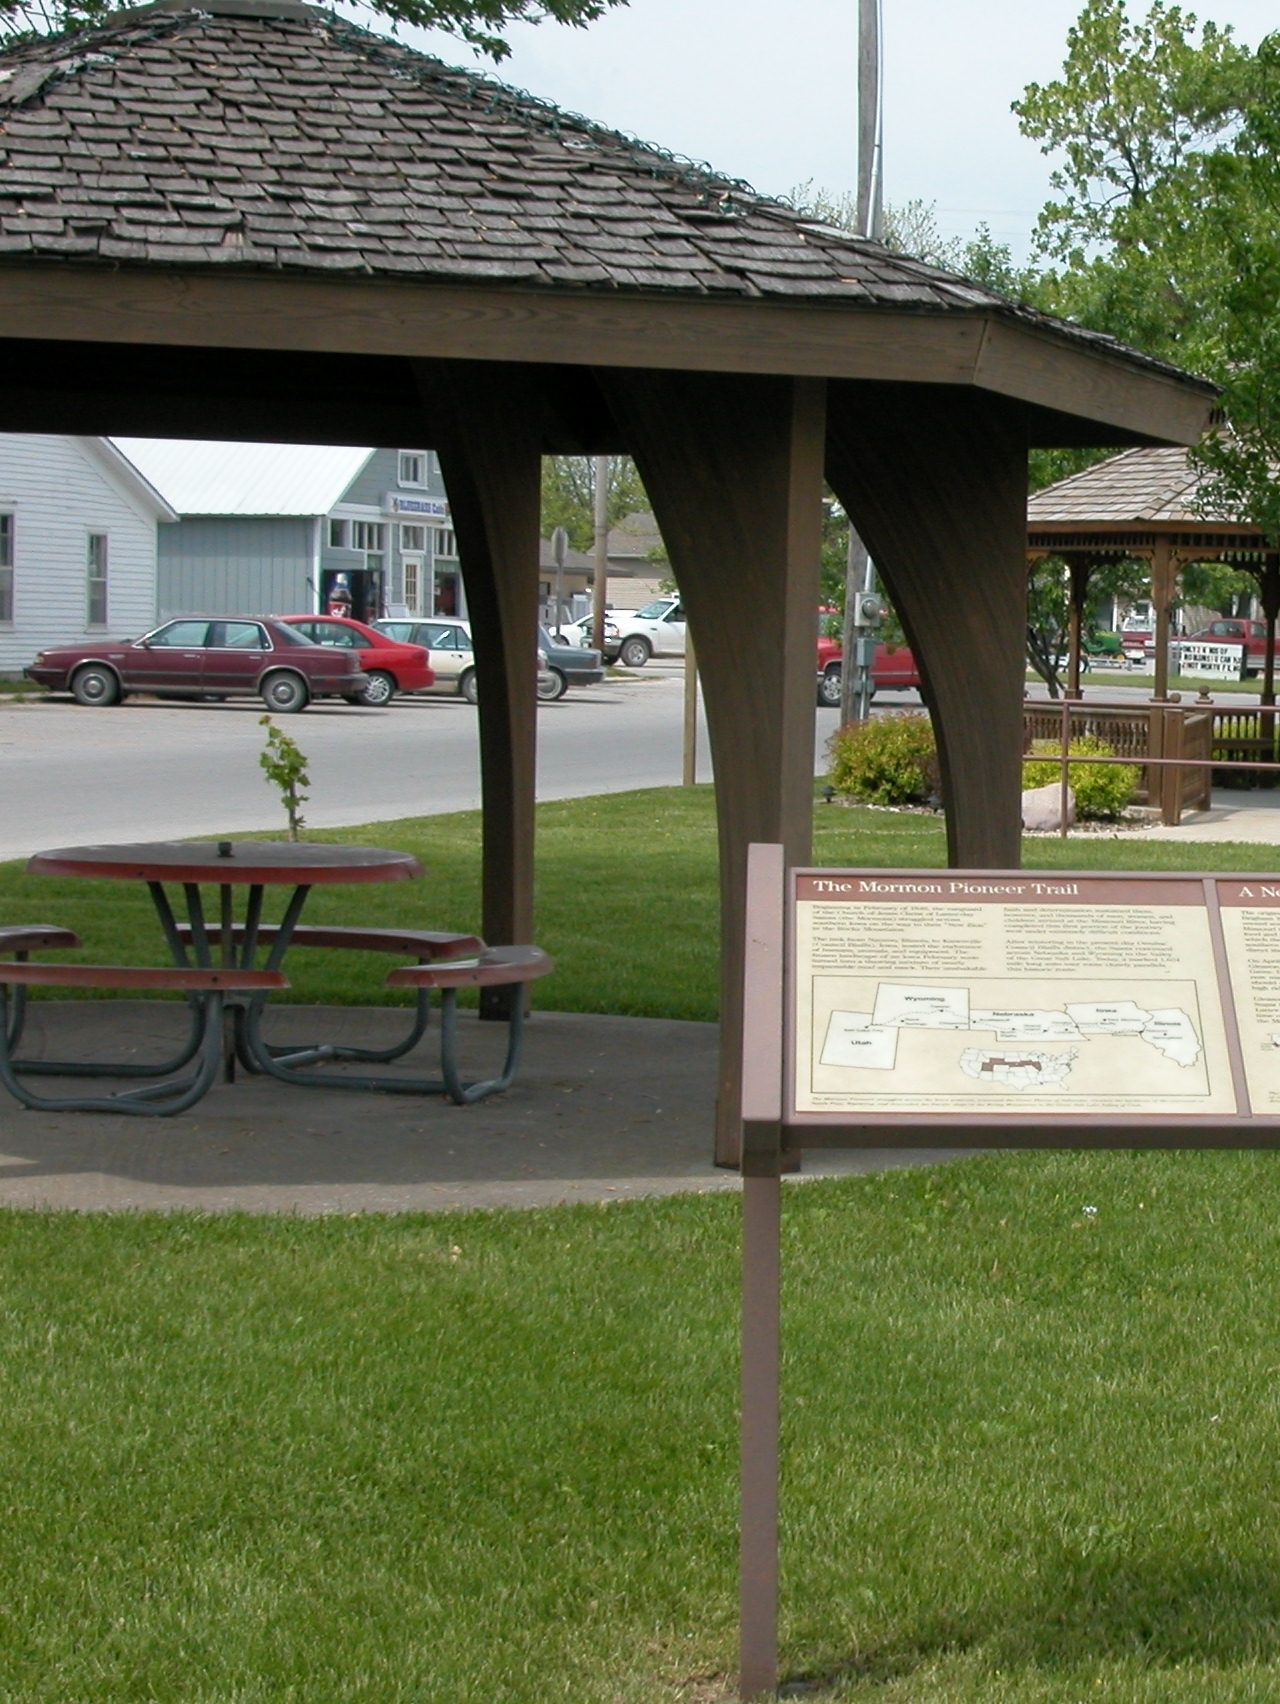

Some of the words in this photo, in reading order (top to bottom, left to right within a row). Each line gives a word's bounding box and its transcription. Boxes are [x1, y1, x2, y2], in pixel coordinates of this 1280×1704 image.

[813, 880, 851, 892] The
[859, 881, 942, 893] Mormon
[949, 882, 1026, 894] Pioneer
[1031, 883, 1079, 895] Trail
[1239, 886, 1254, 897] A
